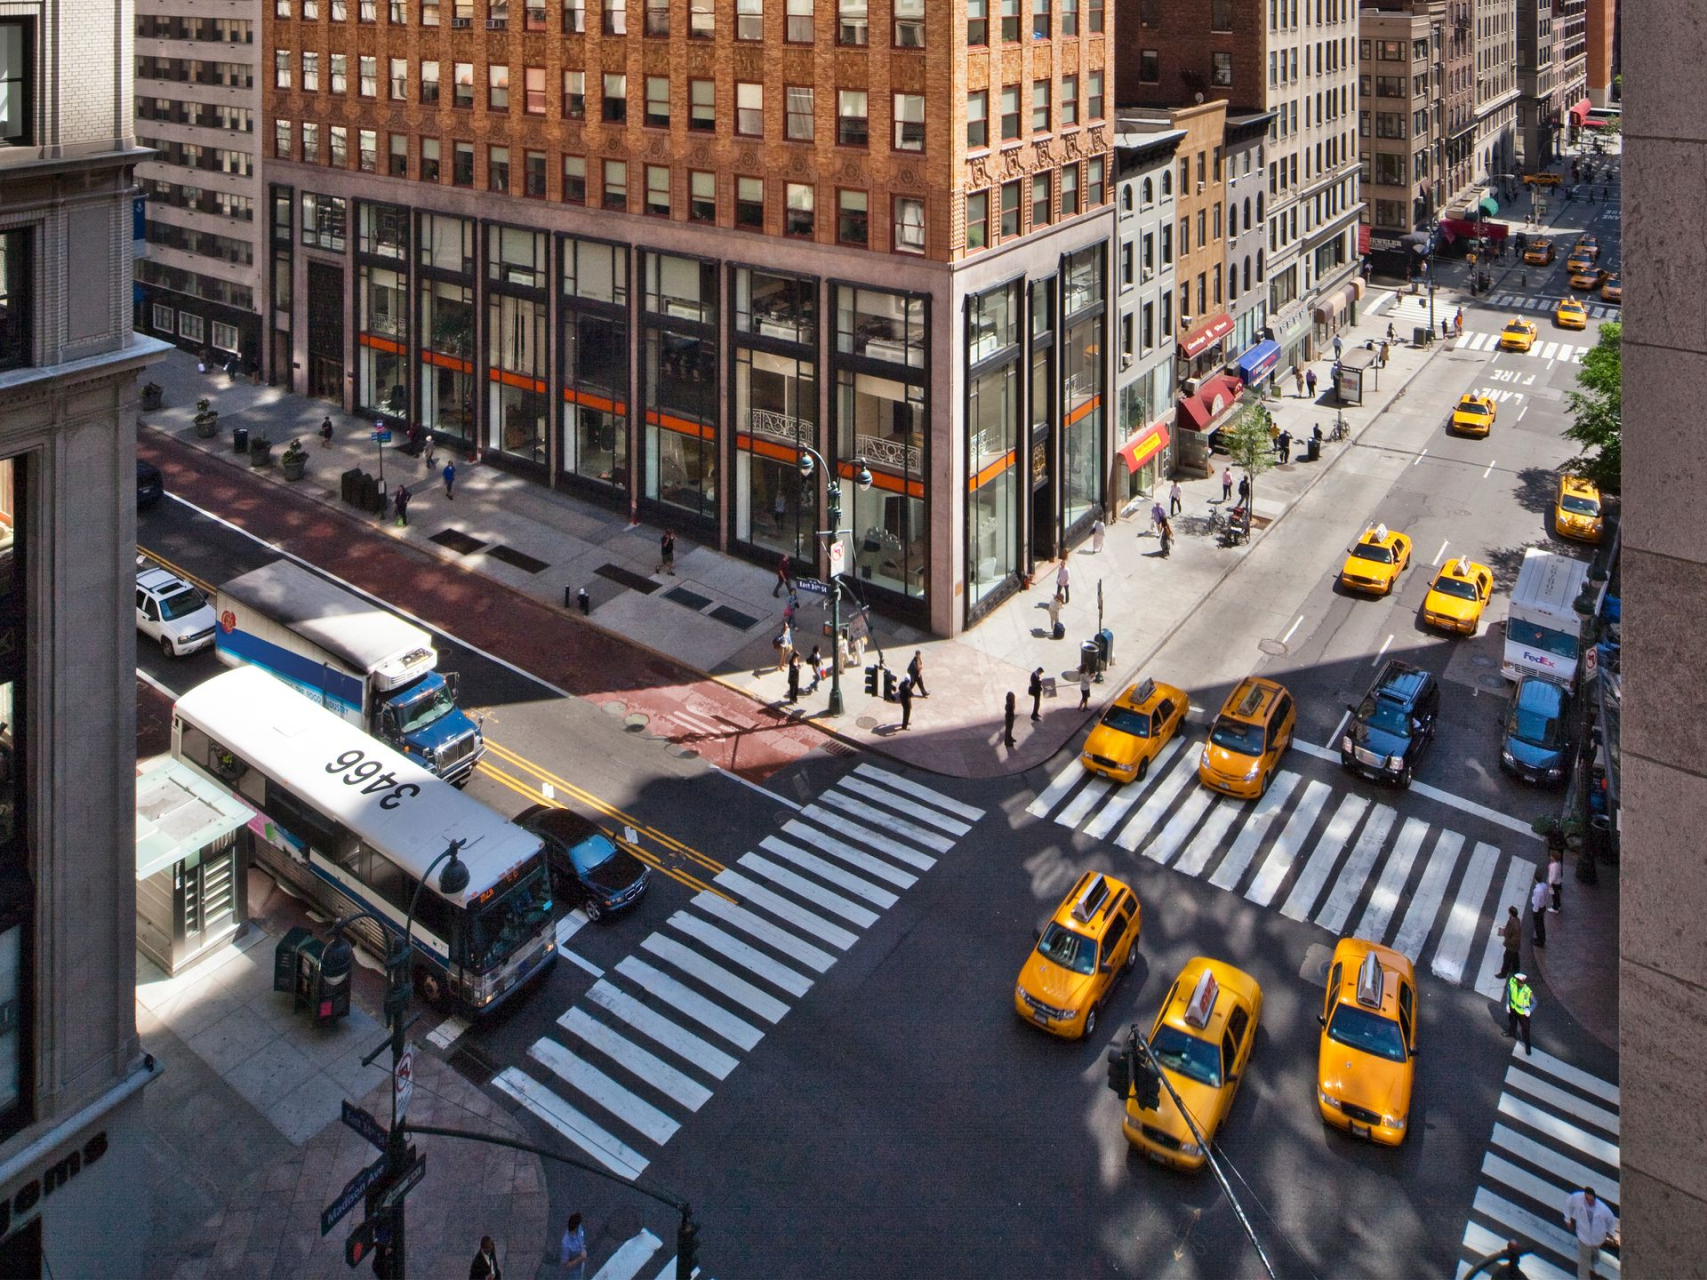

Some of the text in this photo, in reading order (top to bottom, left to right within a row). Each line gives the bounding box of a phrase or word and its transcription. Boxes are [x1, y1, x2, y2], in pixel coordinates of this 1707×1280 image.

[1489, 369, 1537, 386] FIRE
[1523, 651, 1556, 668] FedEx
[325, 749, 420, 810] 3466
[327, 1182, 366, 1225] Madison
[367, 1164, 385, 1186] Ave
